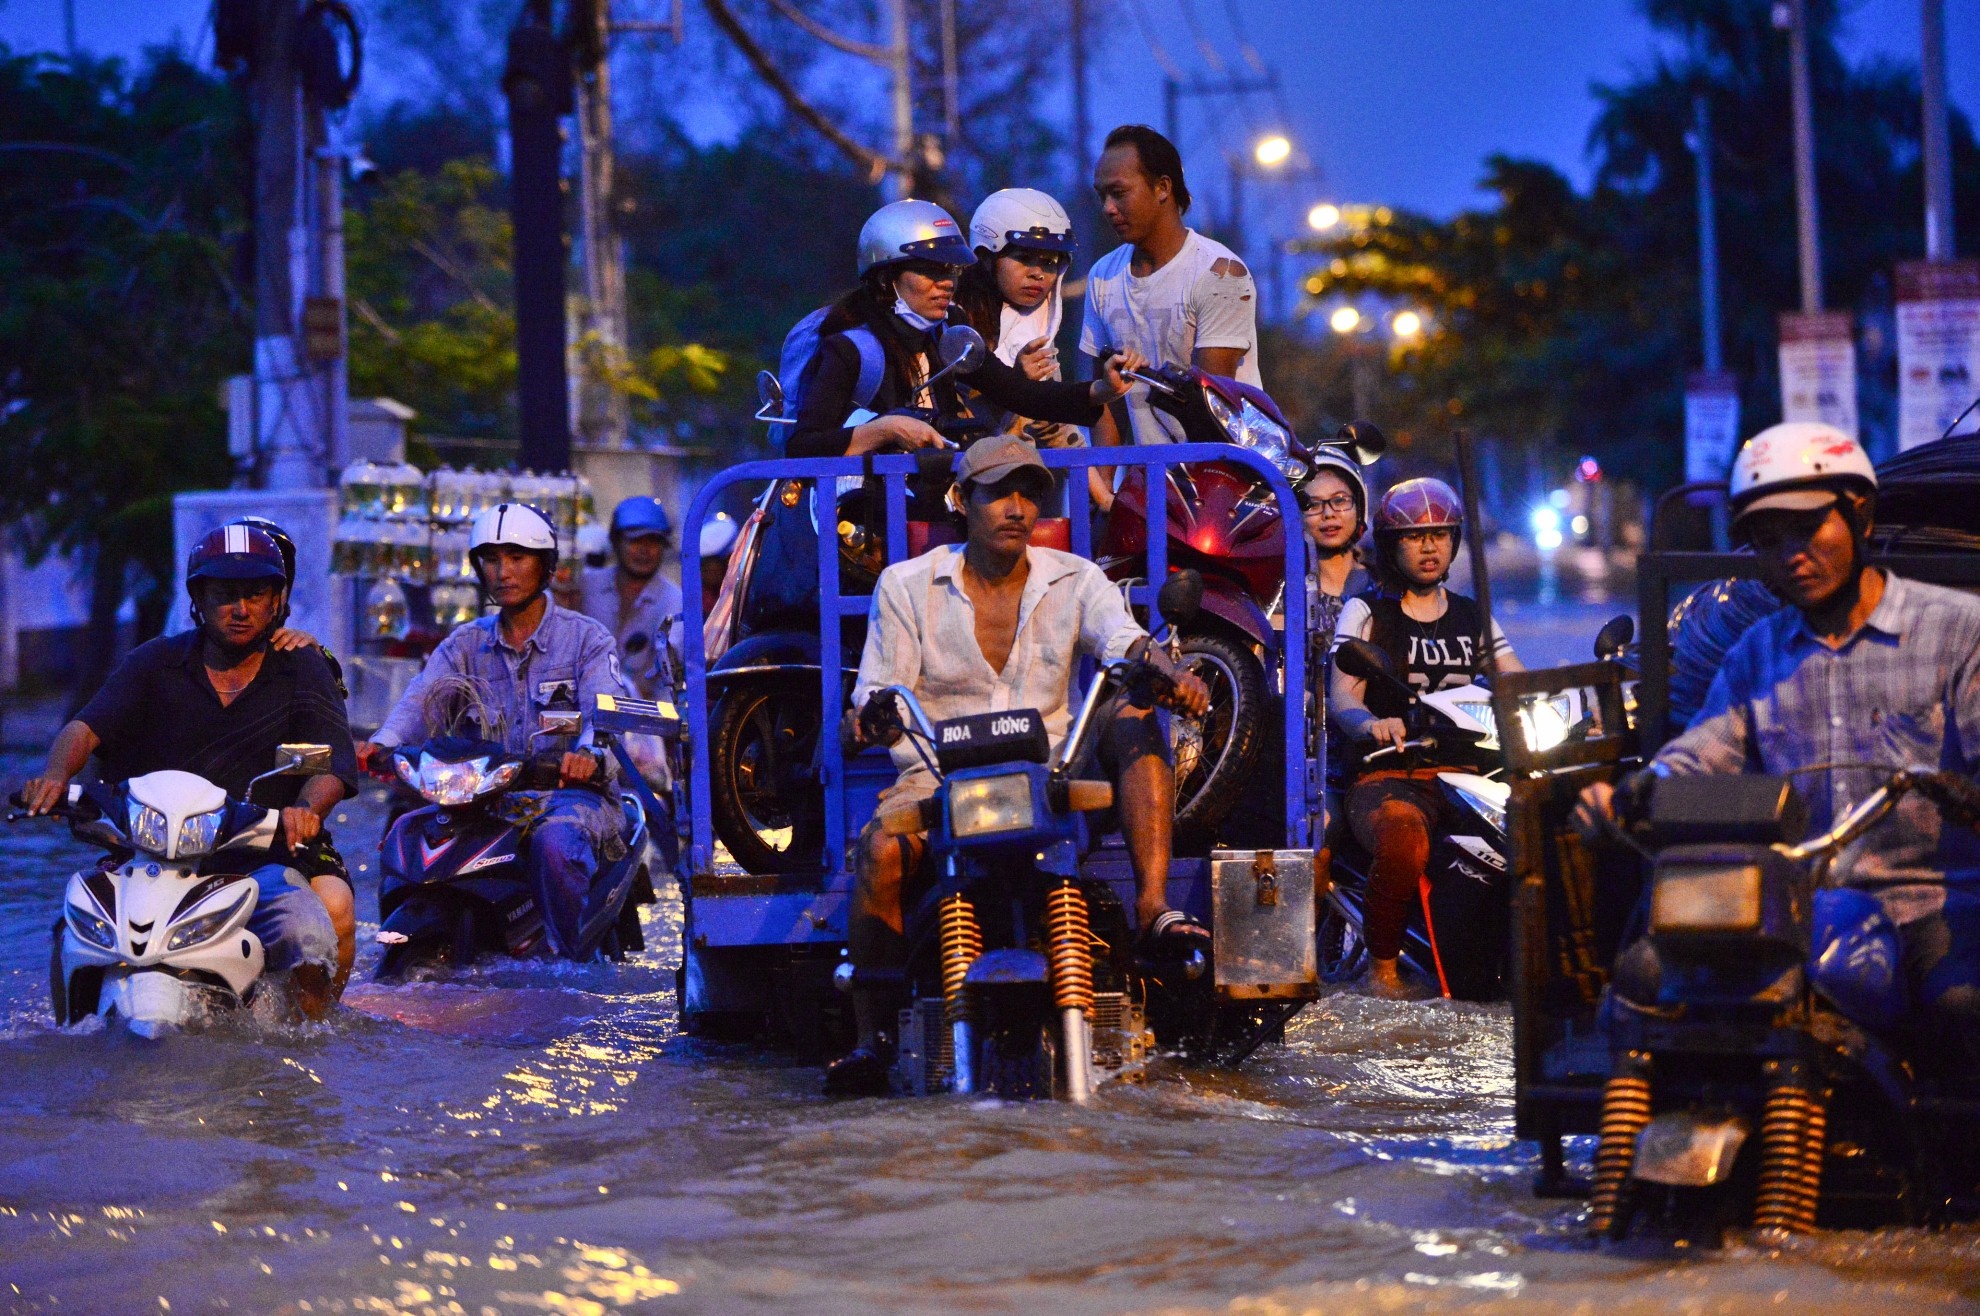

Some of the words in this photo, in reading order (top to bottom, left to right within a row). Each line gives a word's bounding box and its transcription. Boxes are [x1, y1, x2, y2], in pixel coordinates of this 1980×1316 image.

[1203, 468, 1239, 482] HONDA
[943, 725, 972, 743] HOA
[506, 898, 534, 922] YAMAHA
